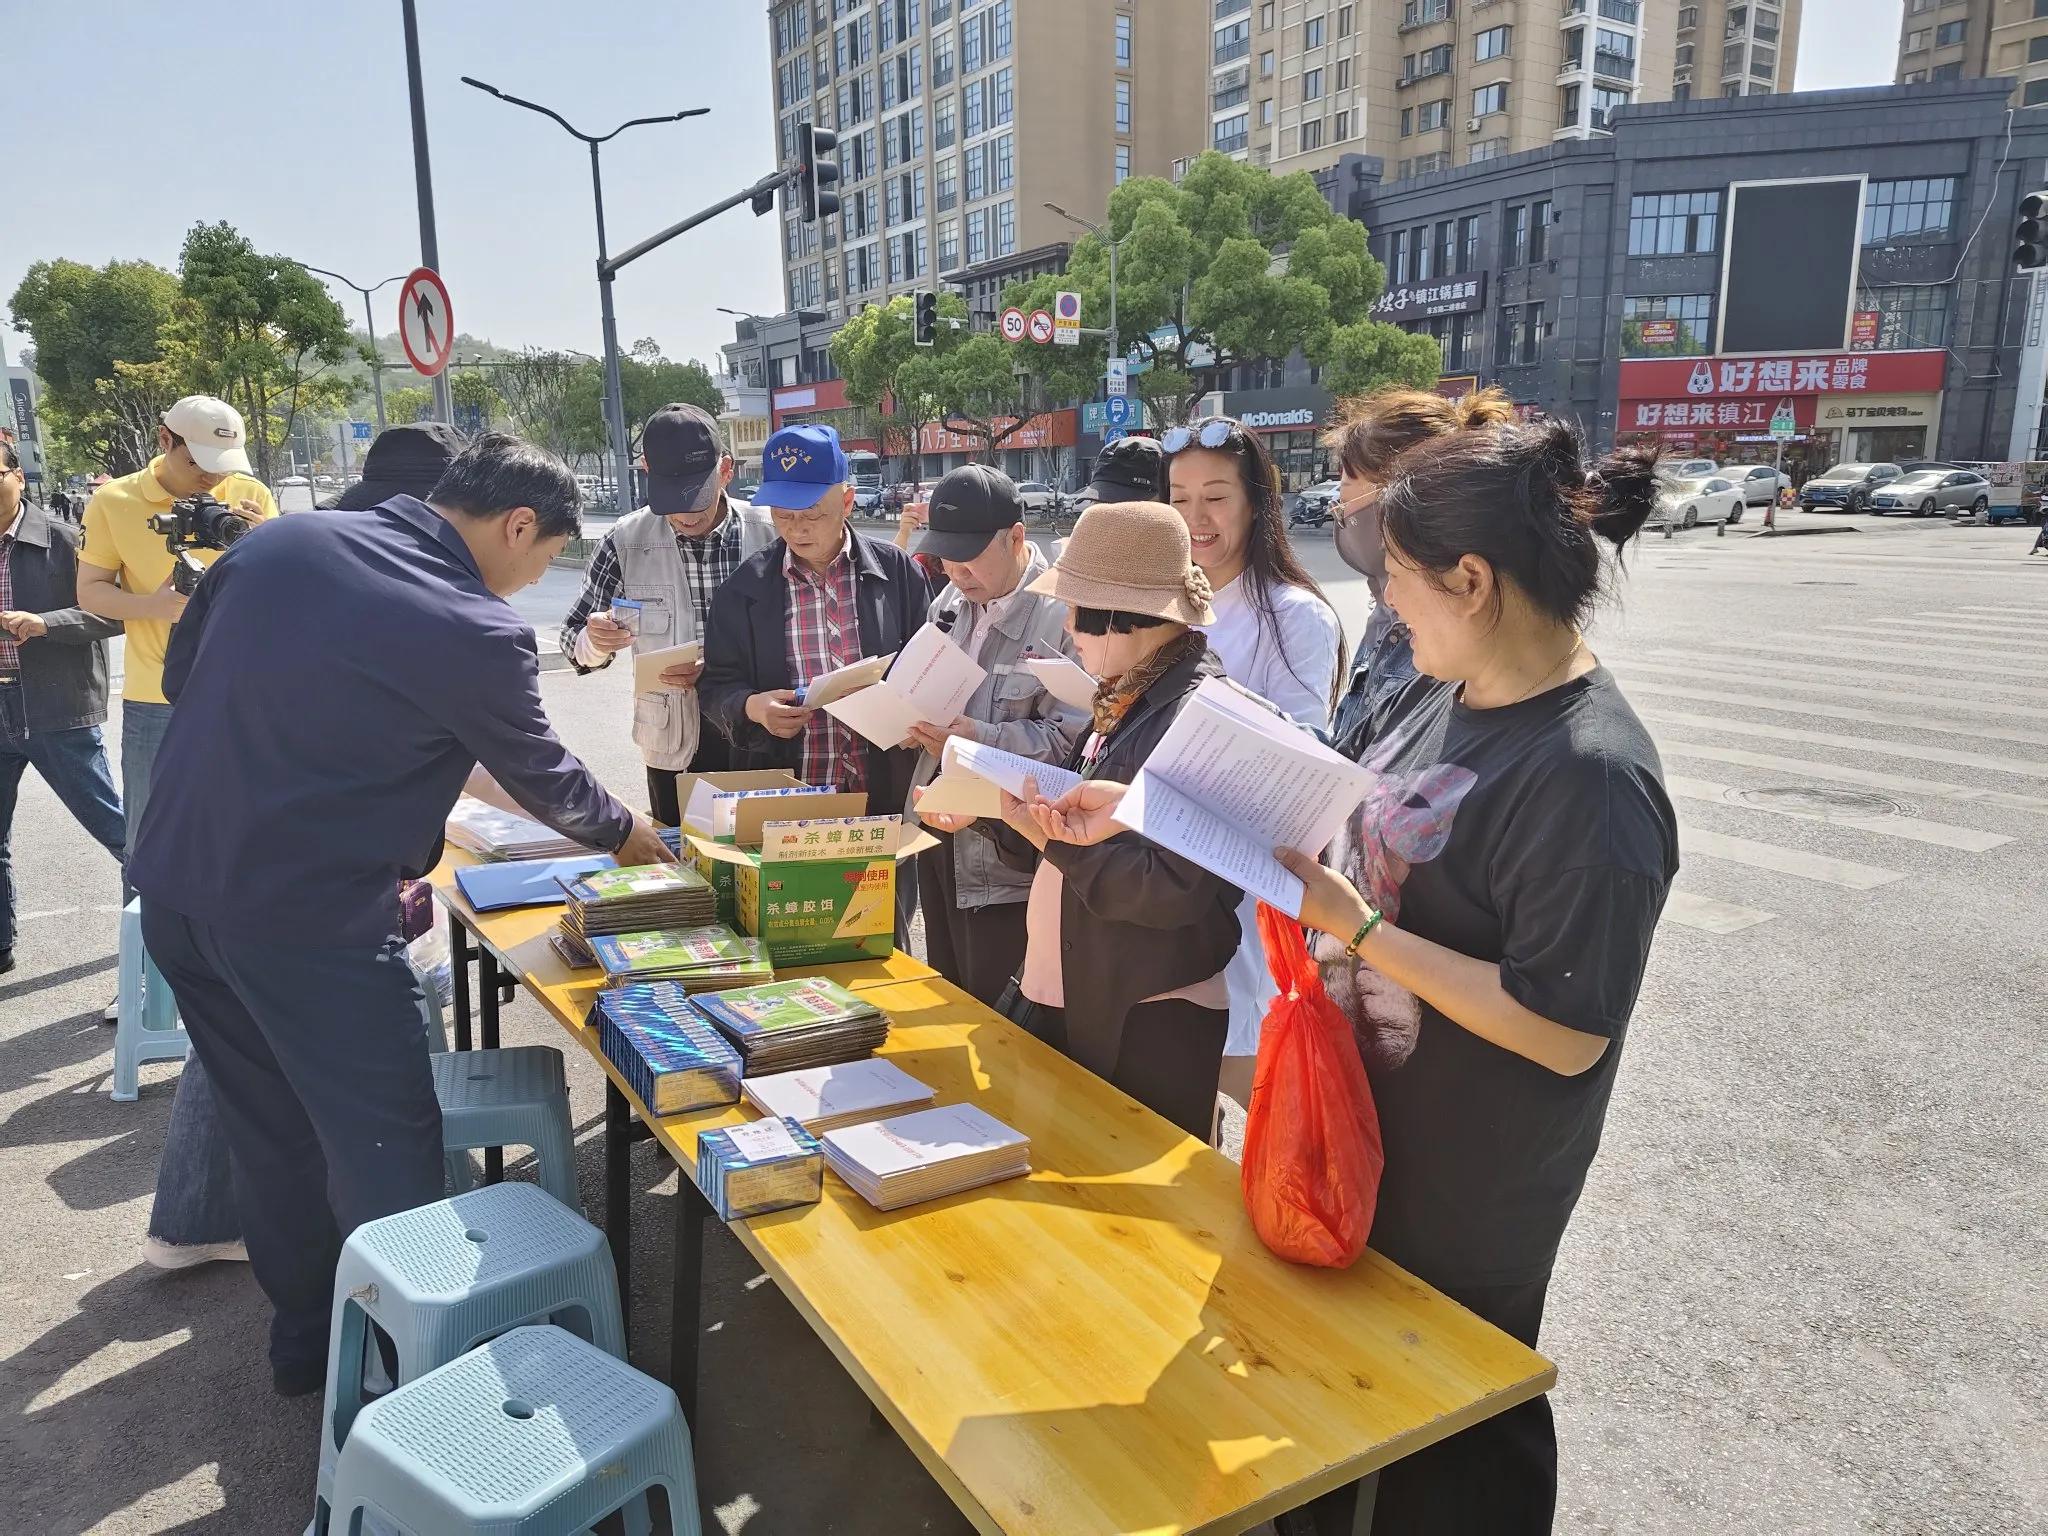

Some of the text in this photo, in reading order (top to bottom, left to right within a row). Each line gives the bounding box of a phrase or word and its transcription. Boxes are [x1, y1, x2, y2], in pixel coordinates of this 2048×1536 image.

[1415, 281, 1478, 305] 镇江锅盖面
[1007, 317, 1022, 332] 50
[1833, 358, 1868, 374] 品牌
[1718, 360, 1830, 393] 好想来
[1832, 374, 1867, 389] 零食
[15, 393, 27, 424] Midea
[1241, 408, 1314, 427] McDonald's
[1636, 402, 1766, 426] 好想来镇江
[804, 827, 886, 845] 杀蟑胶饵
[766, 898, 834, 916] 杀蟑胶饵
